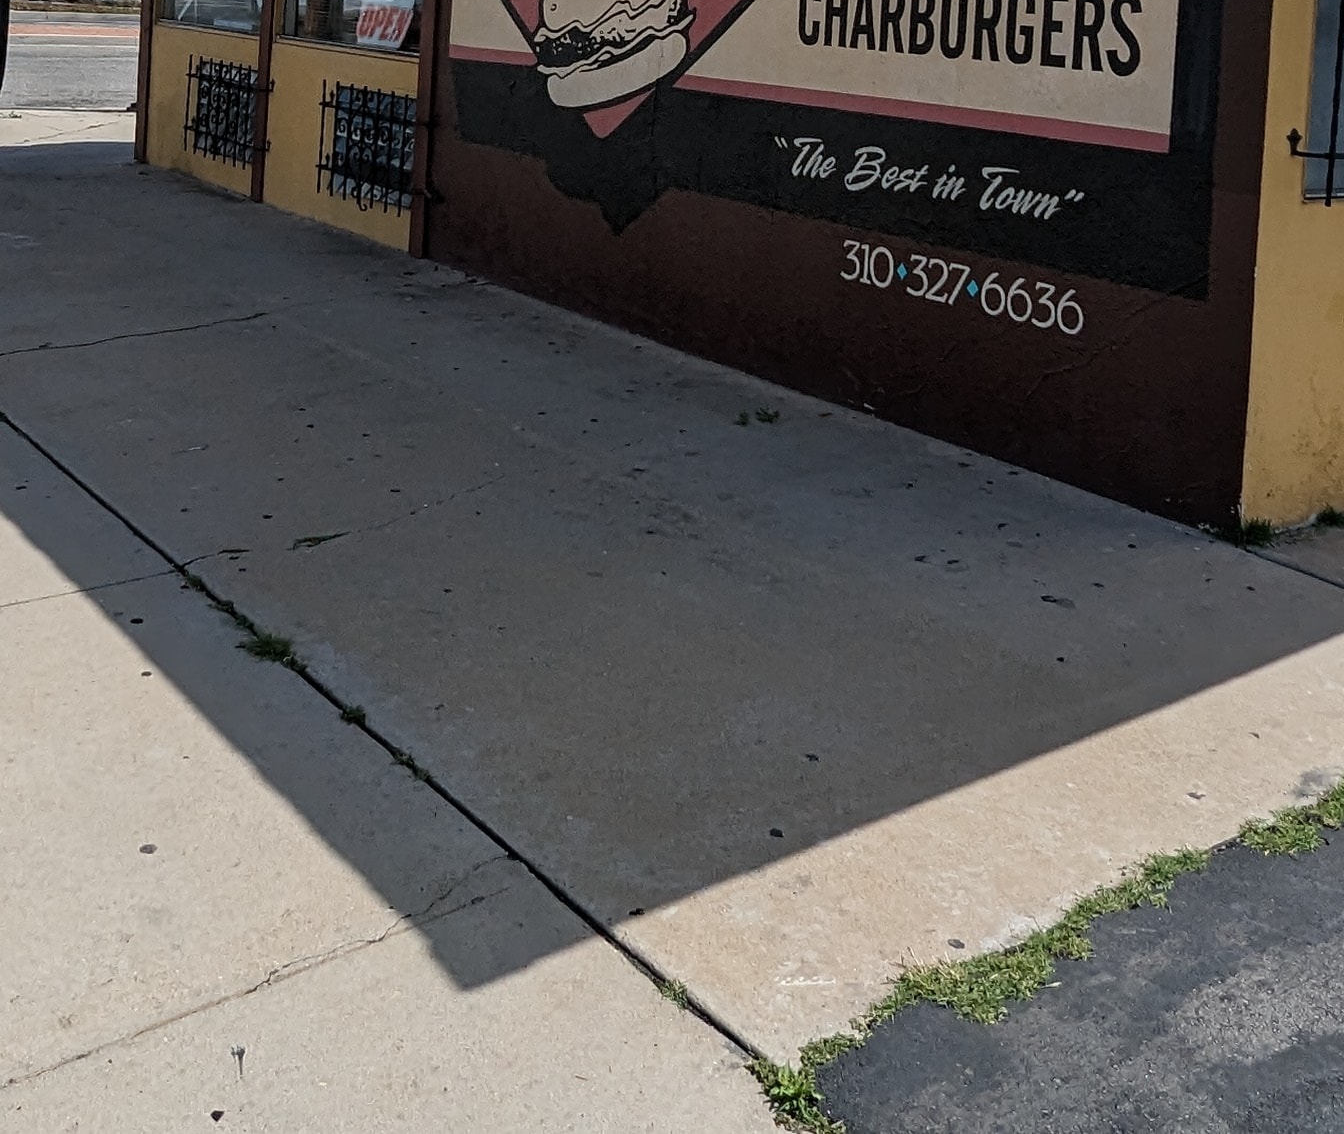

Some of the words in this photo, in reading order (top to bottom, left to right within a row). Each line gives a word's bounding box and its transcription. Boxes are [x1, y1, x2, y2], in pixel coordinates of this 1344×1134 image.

[359, 7, 412, 42] OPEN
[844, 146, 929, 192] Best
[932, 165, 967, 201] in
